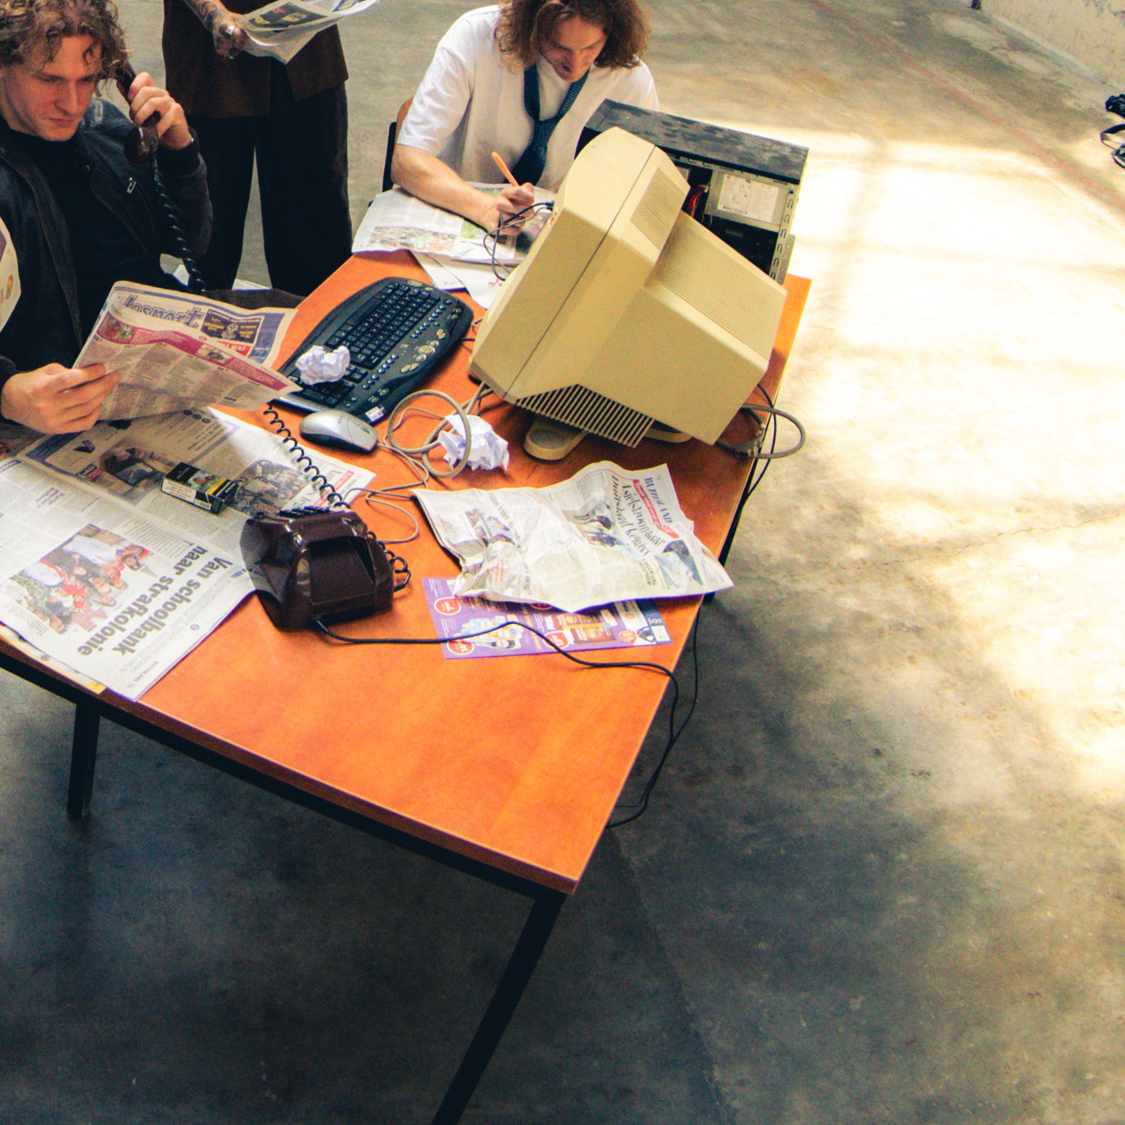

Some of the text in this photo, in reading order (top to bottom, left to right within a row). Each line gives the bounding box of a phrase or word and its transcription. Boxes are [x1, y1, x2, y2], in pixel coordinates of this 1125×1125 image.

[170, 544, 207, 576] naar
[198, 556, 233, 581] Van
[76, 574, 174, 656] strafkolonie
[112, 577, 199, 656] schoolbank
